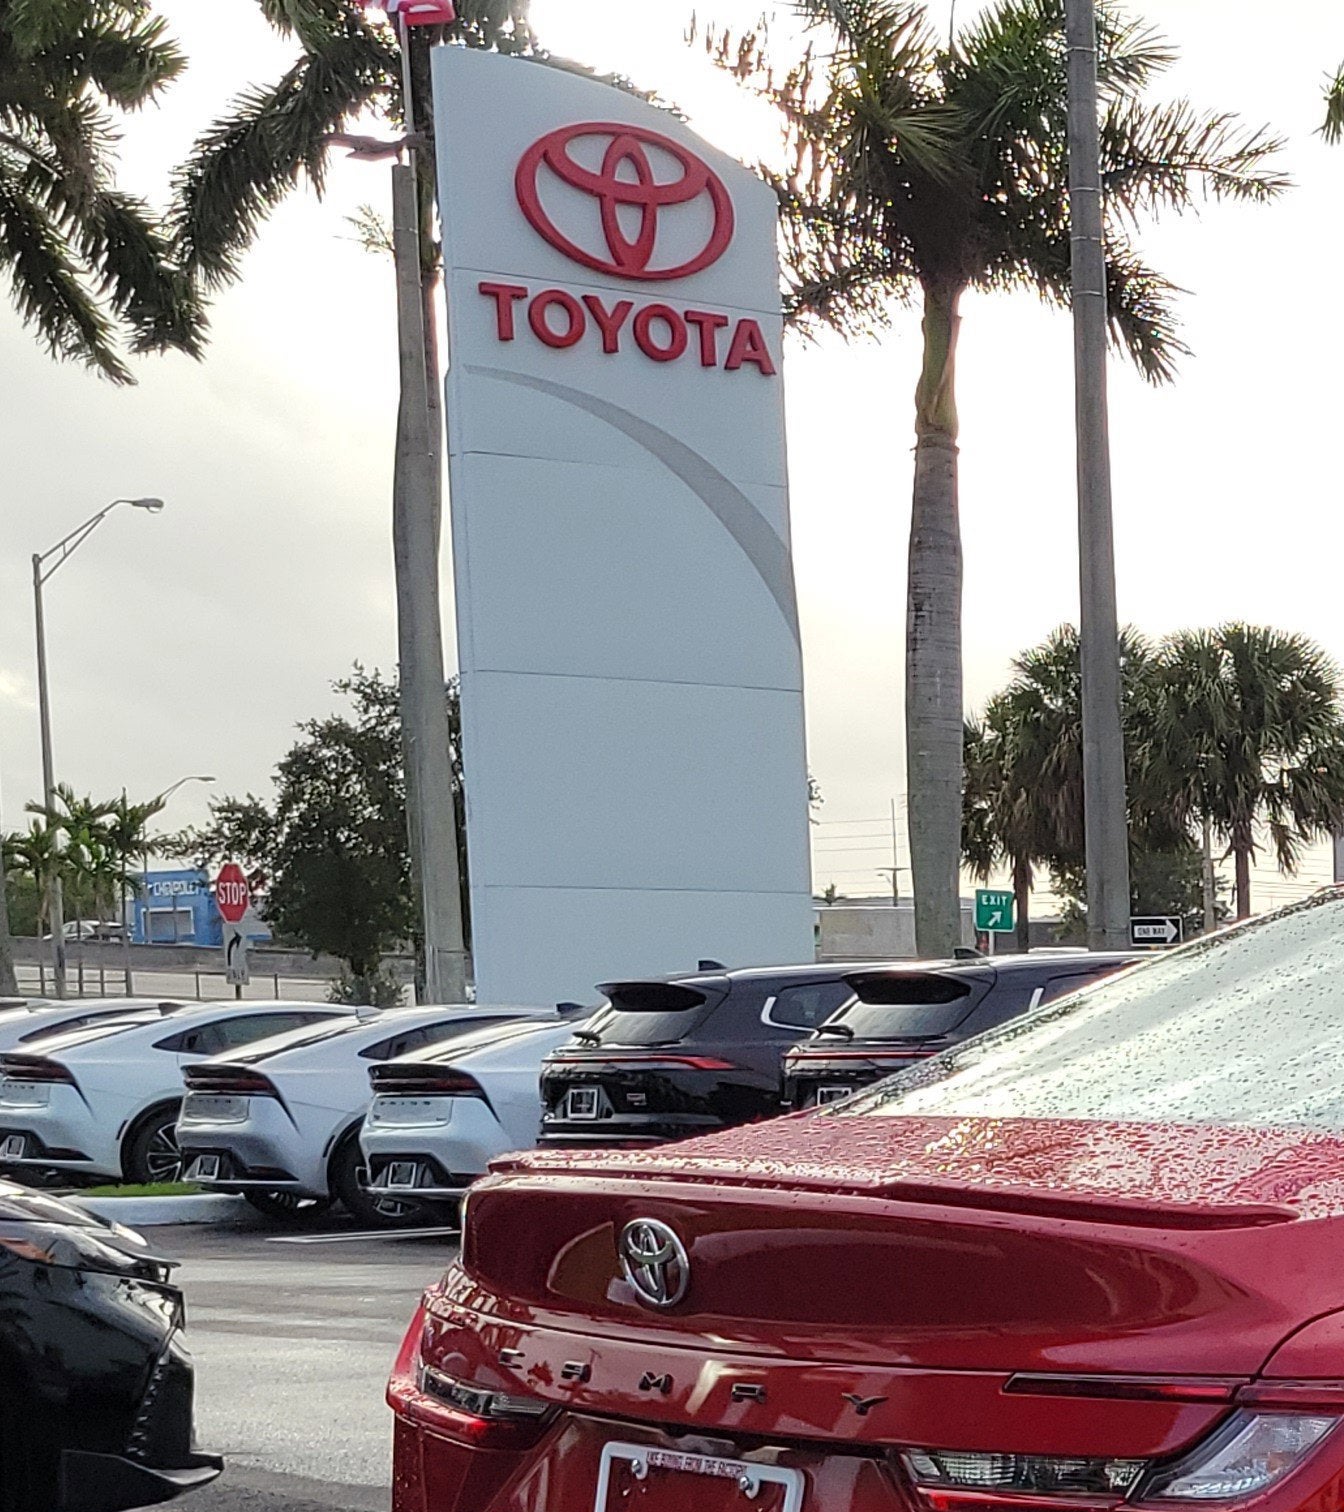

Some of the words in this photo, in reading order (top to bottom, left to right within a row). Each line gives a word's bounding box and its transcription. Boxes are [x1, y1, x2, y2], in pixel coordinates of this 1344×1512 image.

[478, 281, 776, 376] TOYOTA
[218, 881, 247, 906] STOP
[981, 894, 1008, 906] EXIT
[1137, 926, 1151, 937] ONE
[1152, 926, 1166, 937] WAY
[499, 1347, 888, 1416] CAMRY
